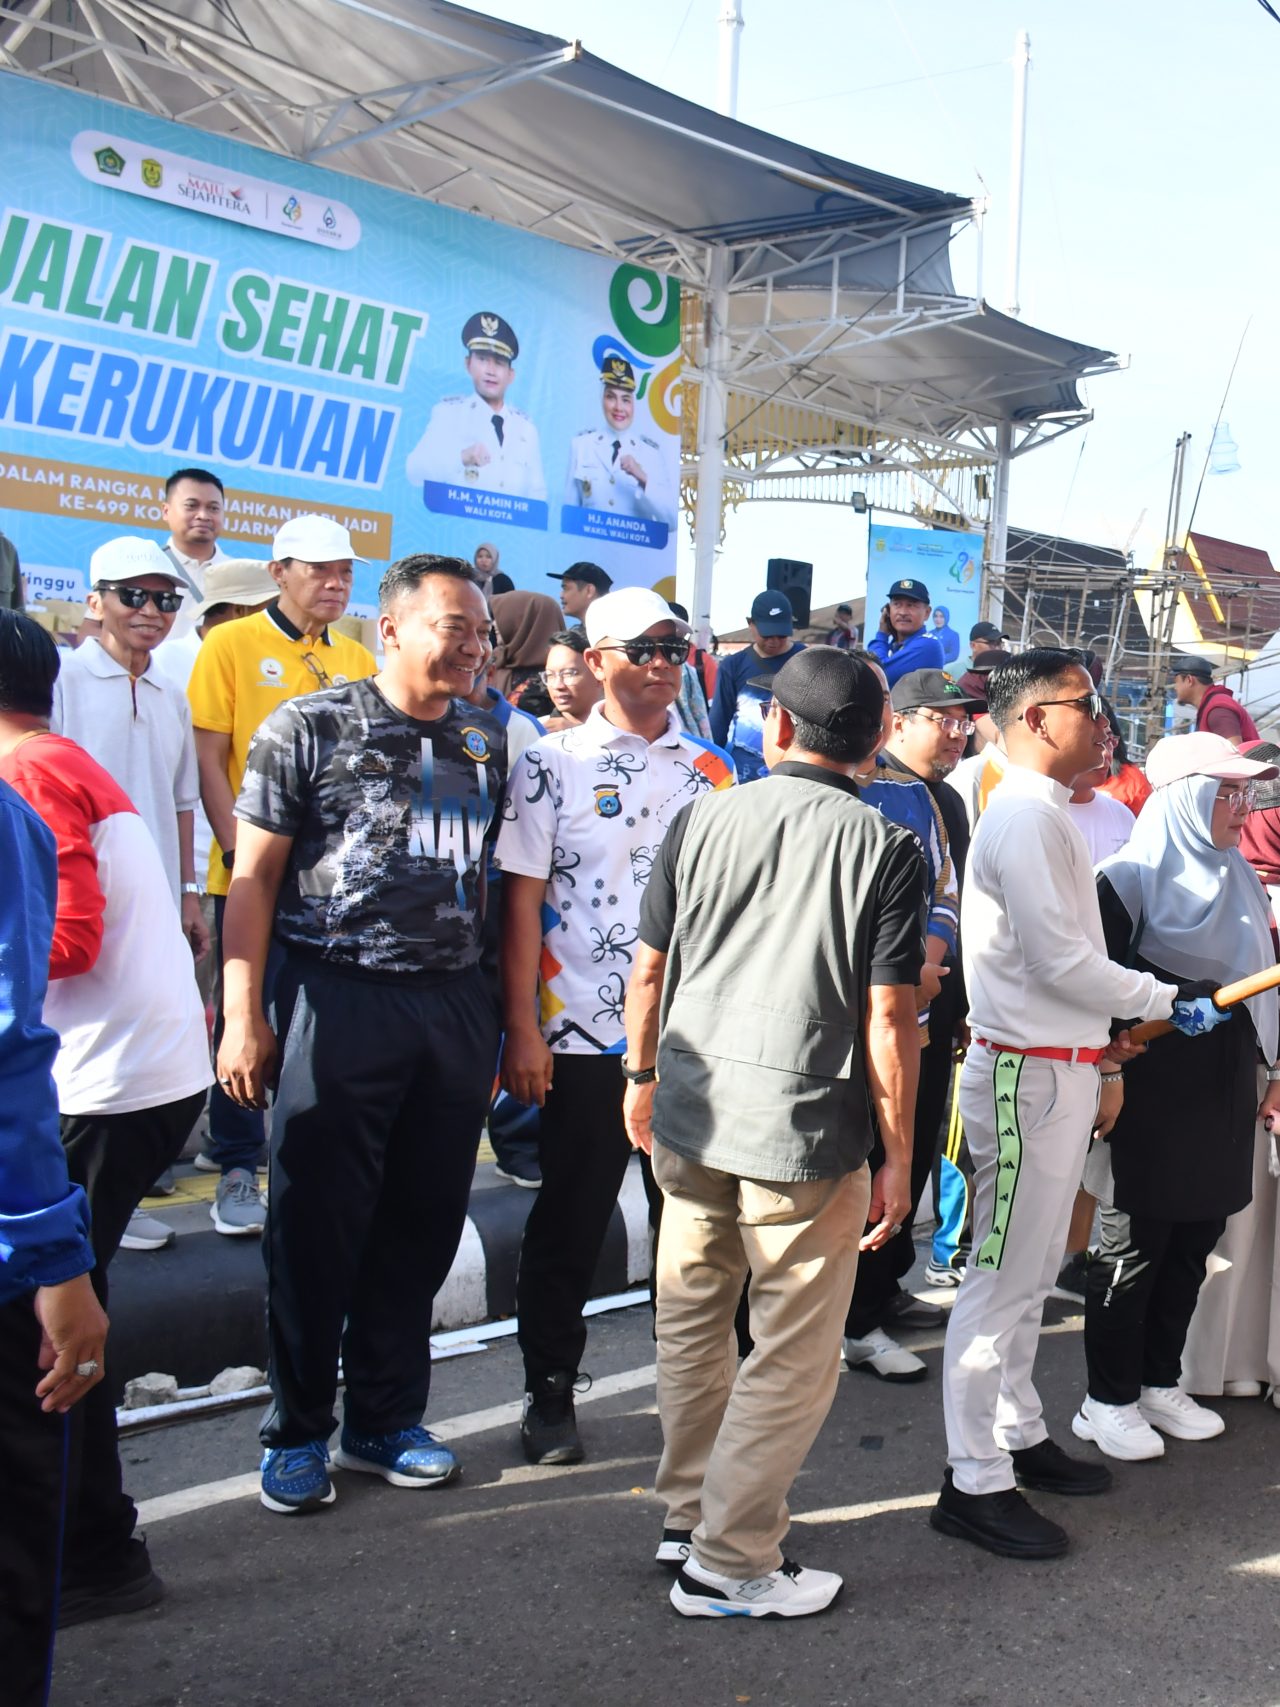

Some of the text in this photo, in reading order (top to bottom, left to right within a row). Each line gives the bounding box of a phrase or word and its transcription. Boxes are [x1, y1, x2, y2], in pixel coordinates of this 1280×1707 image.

[177, 183, 251, 215] SEJAHTERA
[187, 178, 225, 196] MAJU
[0, 215, 424, 386] JALAN SEHAT
[0, 334, 396, 484] KERUKUNAN
[0, 463, 65, 488] DALAM
[70, 474, 153, 501] RANGKA
[343, 516, 379, 534] JADI
[59, 493, 129, 517] KE-499
[448, 489, 529, 513] H.M. YAMIN HR
[464, 505, 513, 520] WALI KOTA
[588, 513, 647, 533] HJ. ANANDA
[583, 525, 651, 543] WAKIL WALI KOTA
[21, 571, 75, 592] inggu
